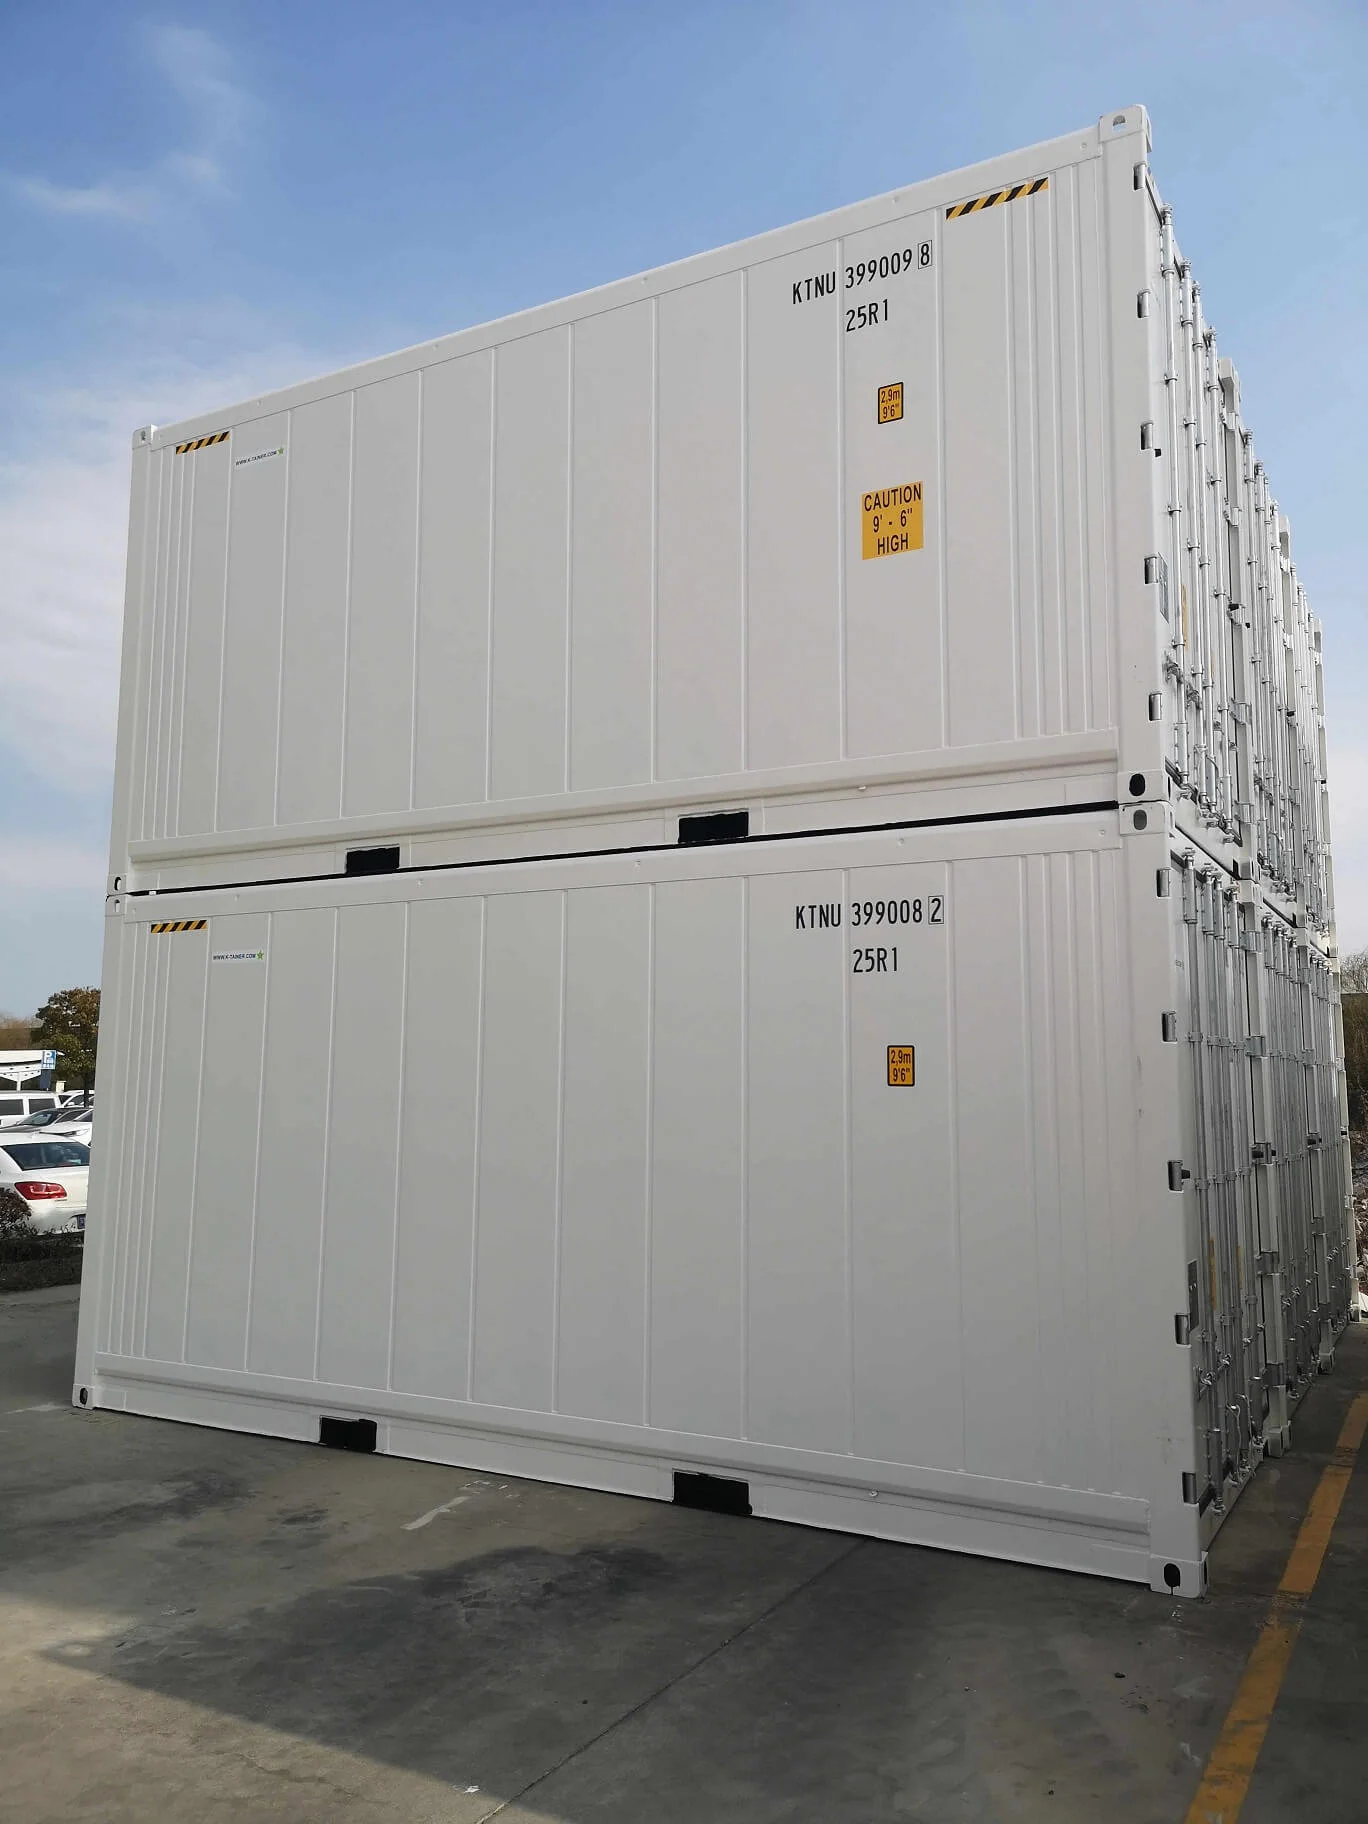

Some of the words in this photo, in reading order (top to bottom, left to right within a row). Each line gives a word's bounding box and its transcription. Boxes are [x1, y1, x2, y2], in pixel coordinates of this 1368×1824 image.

[792, 271, 836, 305] KTNU
[845, 248, 912, 289] 399009
[920, 243, 930, 266] 8
[845, 298, 888, 332] 25R1
[864, 483, 922, 512] CAUTION
[877, 532, 909, 555] HIGH
[795, 903, 841, 929] KTNU
[851, 898, 923, 926] 399008
[930, 897, 942, 923] 2
[853, 947, 898, 973] 25R1
